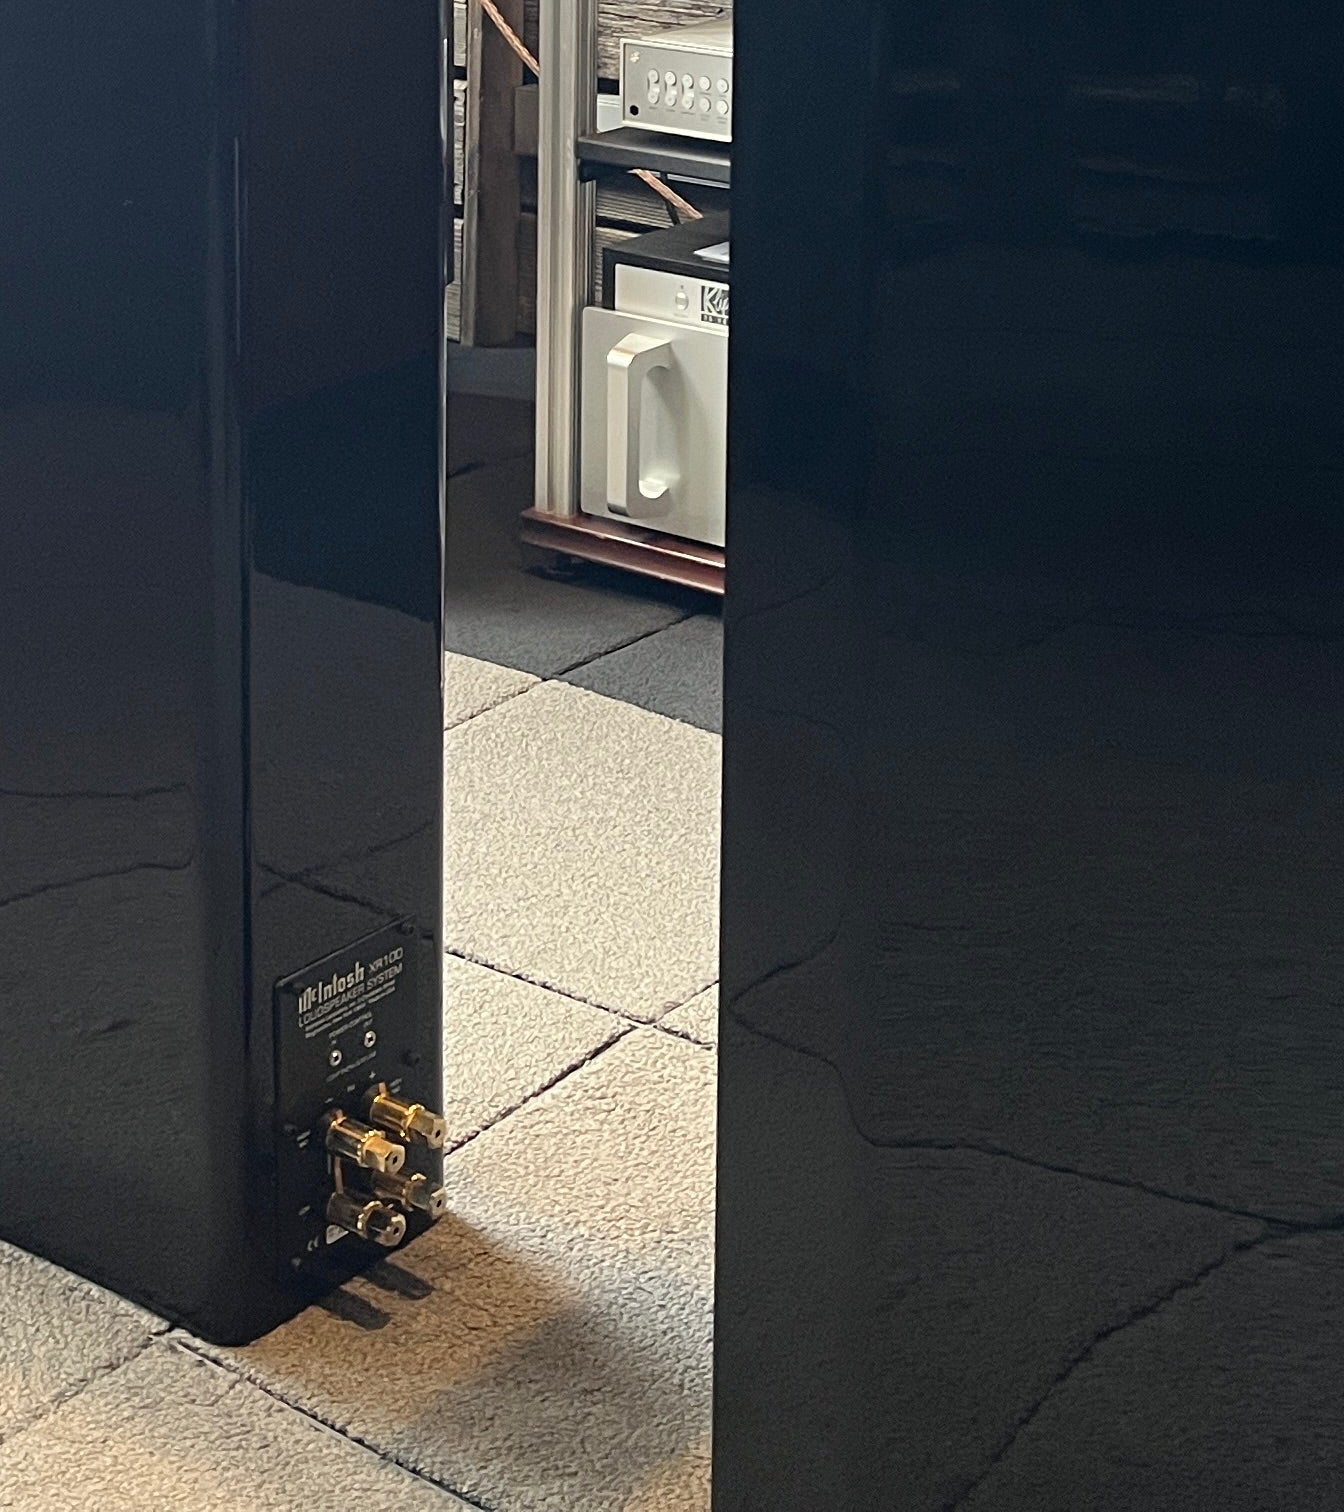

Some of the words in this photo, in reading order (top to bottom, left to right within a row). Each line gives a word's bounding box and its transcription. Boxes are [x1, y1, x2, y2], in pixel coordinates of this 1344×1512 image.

[298, 961, 365, 1015] McIntosh
[368, 947, 403, 974] XR100
[298, 983, 365, 1028] LOUDSPEAKER
[367, 962, 403, 990] SYSTEM
